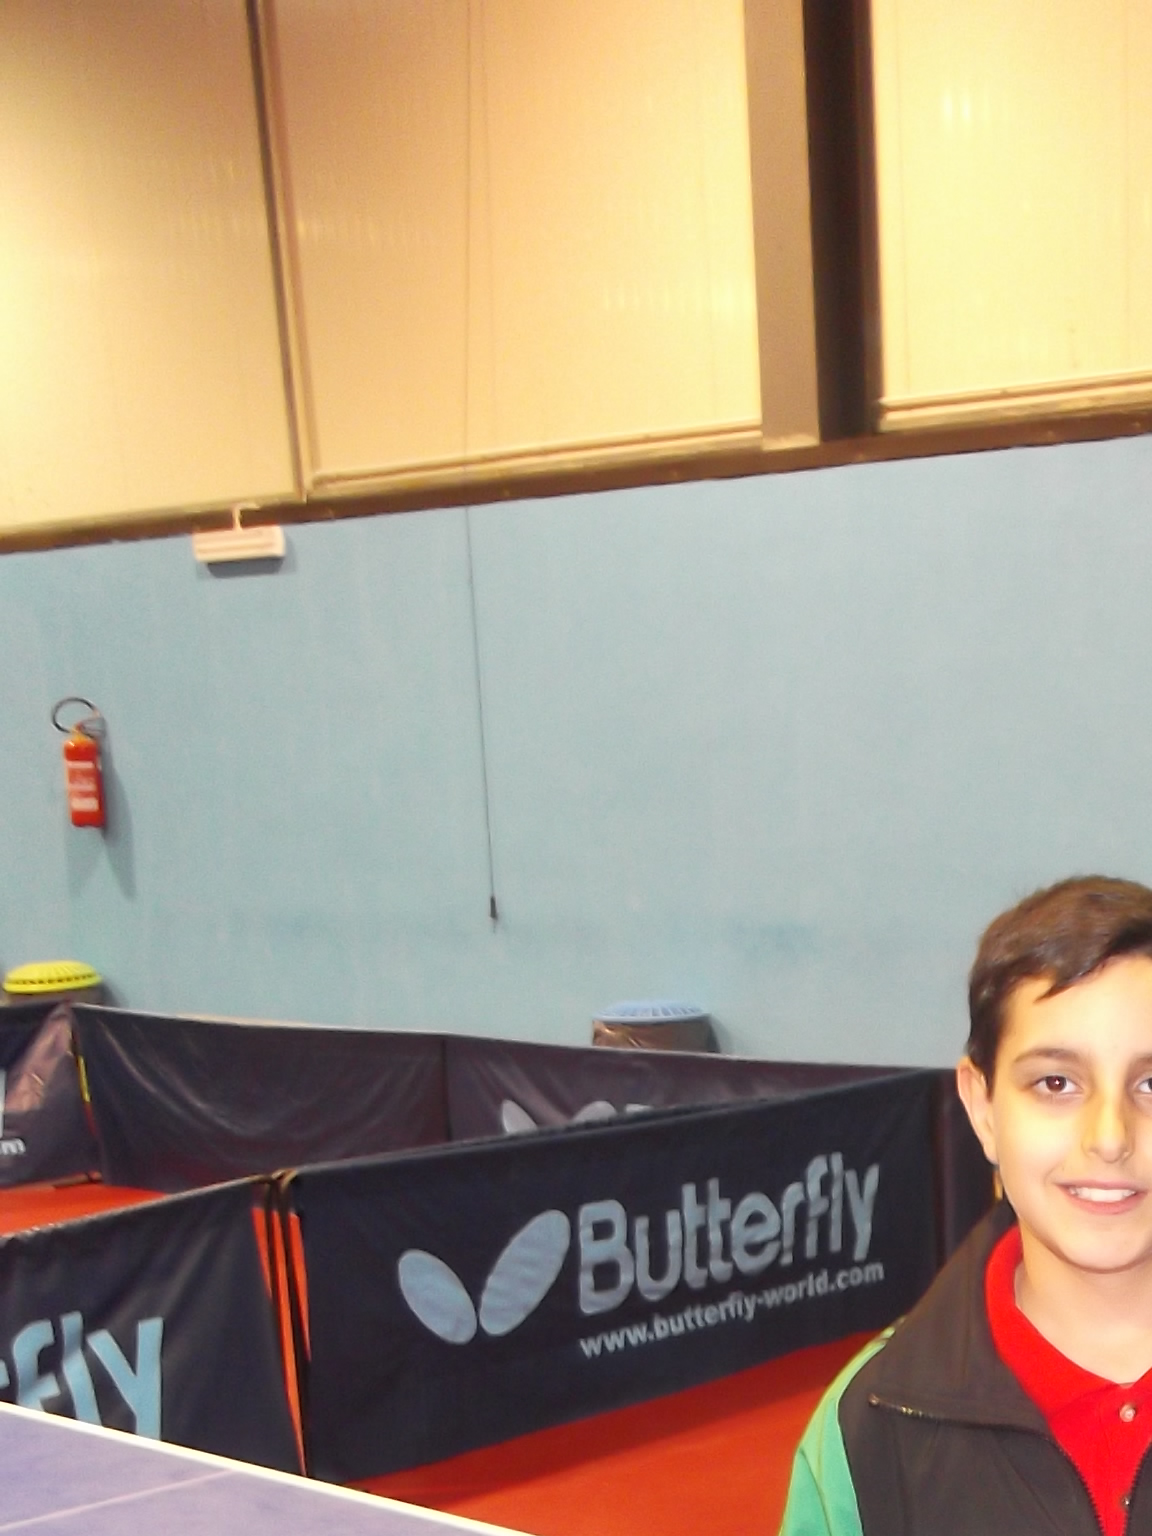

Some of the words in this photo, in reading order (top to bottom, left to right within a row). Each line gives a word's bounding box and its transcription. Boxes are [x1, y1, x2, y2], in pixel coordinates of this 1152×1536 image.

[579, 1152, 880, 1315] Butterfly
[580, 1262, 885, 1359] www.butterfly-world.com
[0, 1311, 164, 1441] fly
